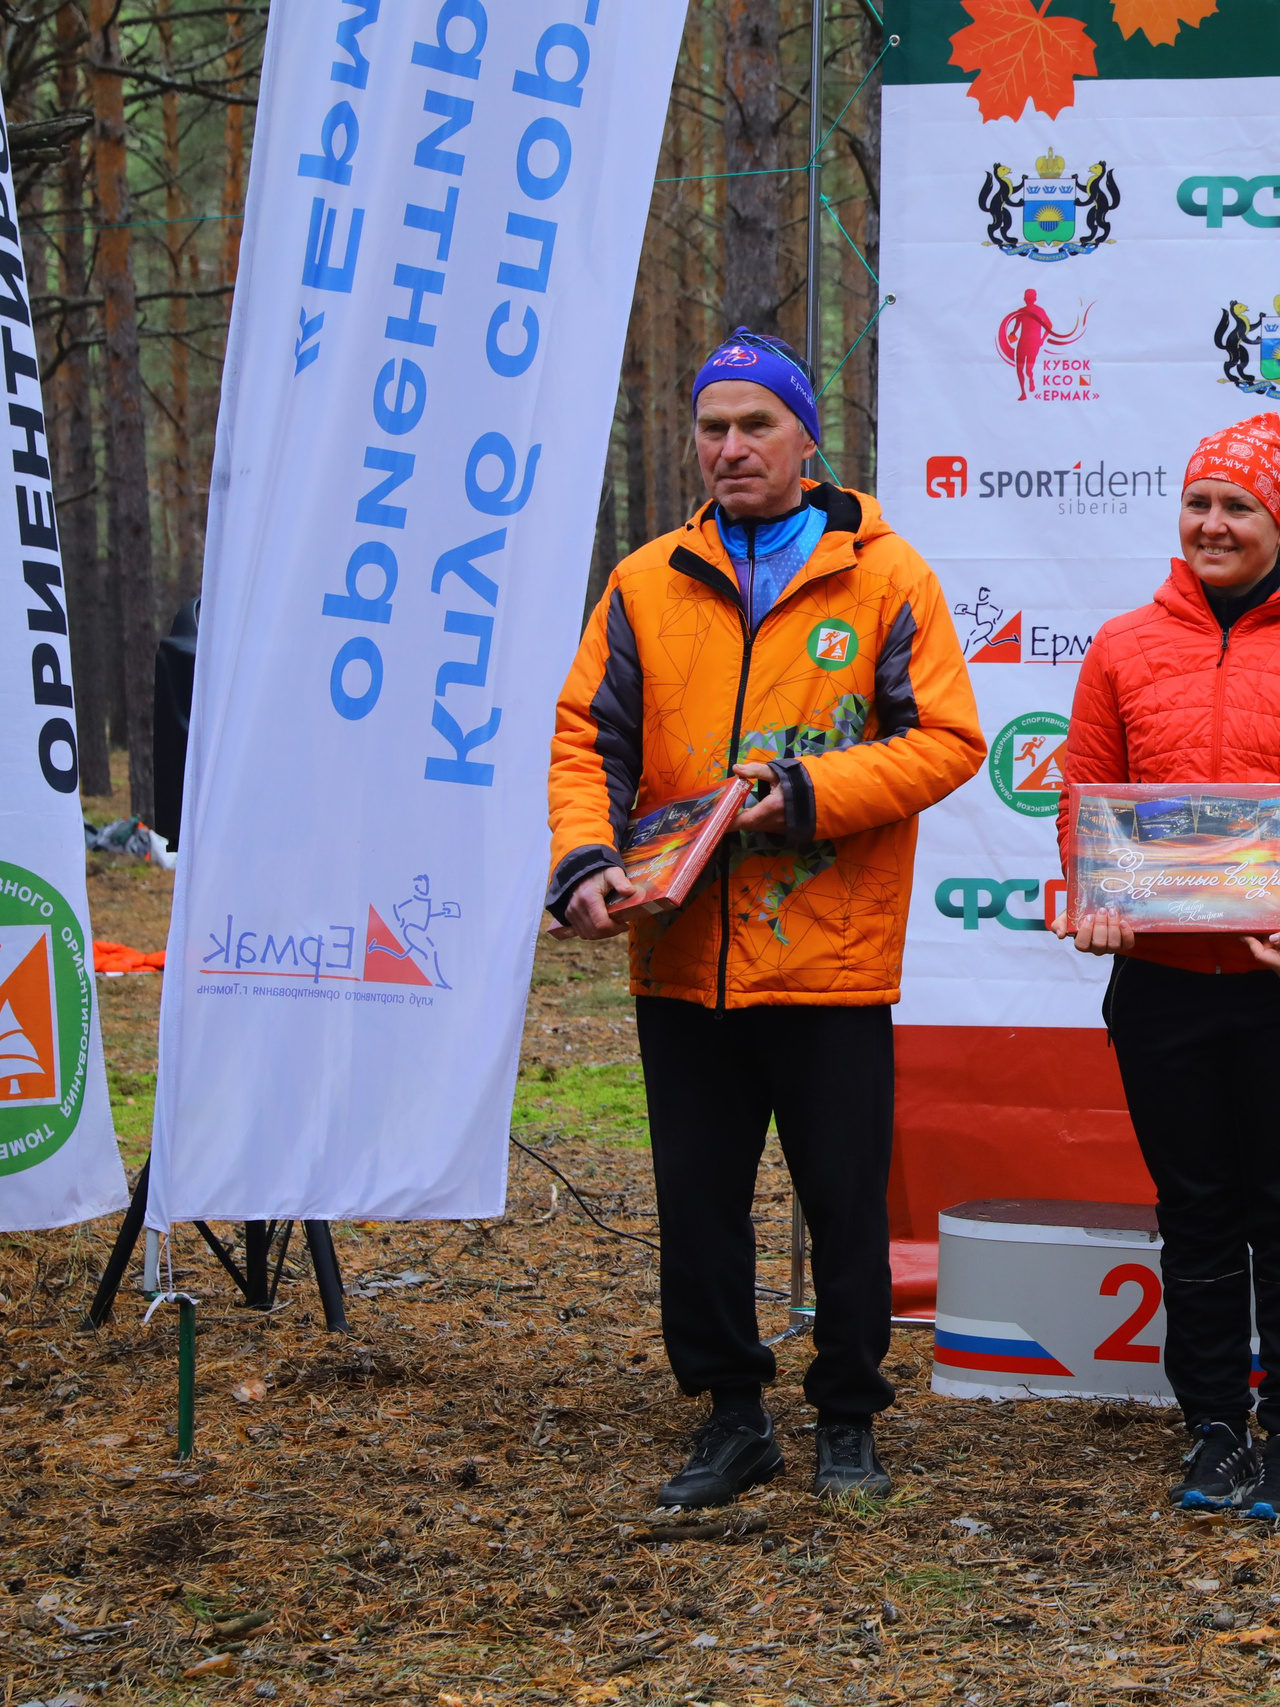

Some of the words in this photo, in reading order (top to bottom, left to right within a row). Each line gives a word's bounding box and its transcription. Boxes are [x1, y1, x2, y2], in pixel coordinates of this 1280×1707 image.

[1043, 360, 1090, 371] КУБОК
[1043, 375, 1073, 386] КСО
[1034, 390, 1100, 401] «ЕРМАК»
[1208, 456, 1250, 474] BAIKAL
[979, 460, 1167, 498] SPORTident
[1059, 498, 1127, 515] siberia
[1031, 626, 1092, 666] Ерм
[1017, 802, 1059, 812] ЮМЕНСКОЙ
[1100, 847, 1220, 899] Заречные
[61, 926, 89, 1119] ОРИЕНТИРОВАНИЯ
[1094, 1263, 1162, 1363] 2
